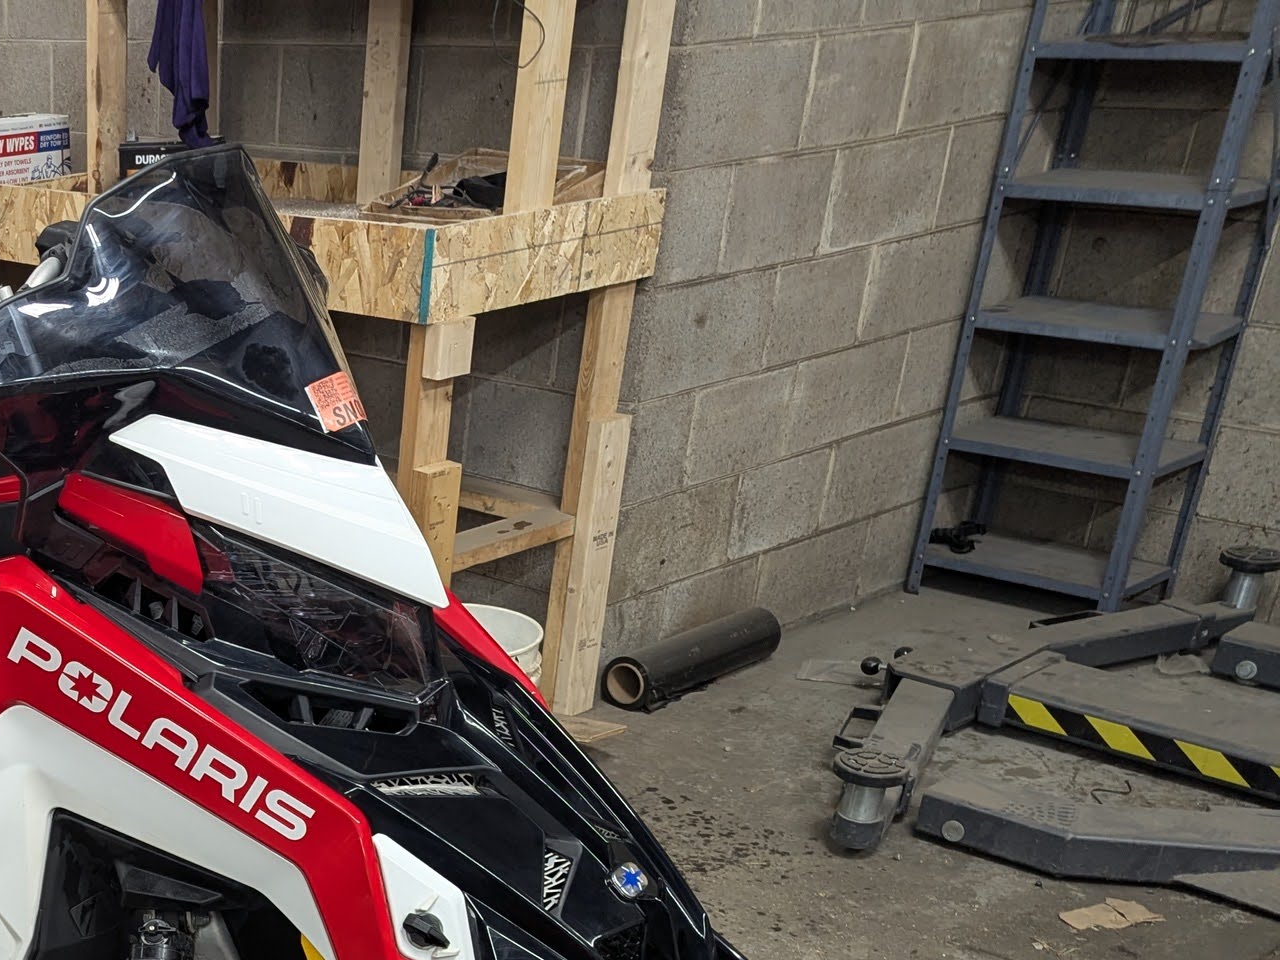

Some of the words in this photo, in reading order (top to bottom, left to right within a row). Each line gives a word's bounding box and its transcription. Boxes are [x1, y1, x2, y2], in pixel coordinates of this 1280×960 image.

[6, 135, 35, 153] WYPES
[40, 132, 69, 142] REINFORED
[40, 140, 49, 149] DRY
[50, 139, 69, 148] TOWLS
[7, 626, 316, 841] POLARIS
